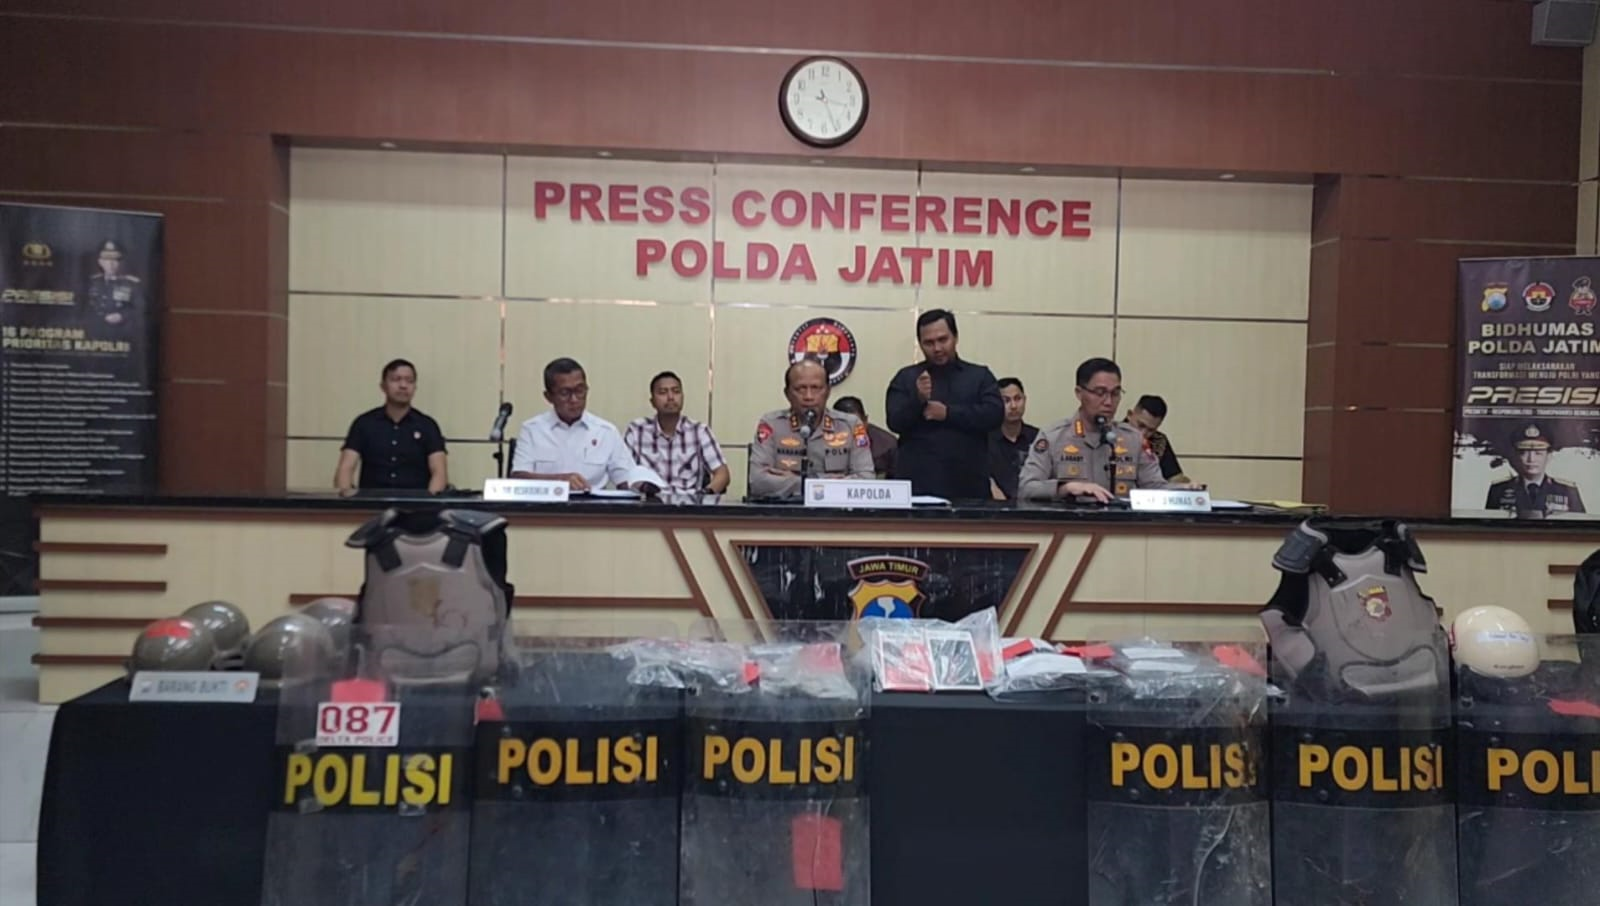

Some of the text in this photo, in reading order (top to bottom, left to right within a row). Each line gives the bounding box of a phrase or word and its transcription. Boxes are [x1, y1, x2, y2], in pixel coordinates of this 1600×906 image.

[534, 180, 1092, 238] PRESS CONFERENCE
[635, 238, 994, 288] POLDA JATIM
[20, 327, 85, 339] PROGRAM
[1481, 322, 1594, 338] BIDHUMAS
[2, 338, 130, 352] PRIORITAS KAPOLRI
[1468, 341, 1536, 354] POLDA
[847, 488, 891, 499] KAPOLDA
[859, 562, 919, 574] JAWA TIMUR
[321, 706, 396, 734] 087
[354, 735, 394, 744] POLICE
[497, 736, 658, 785] POLISI
[704, 735, 854, 784] POLISI
[1299, 743, 1443, 791] POLISI
[284, 753, 453, 806] POLISI
